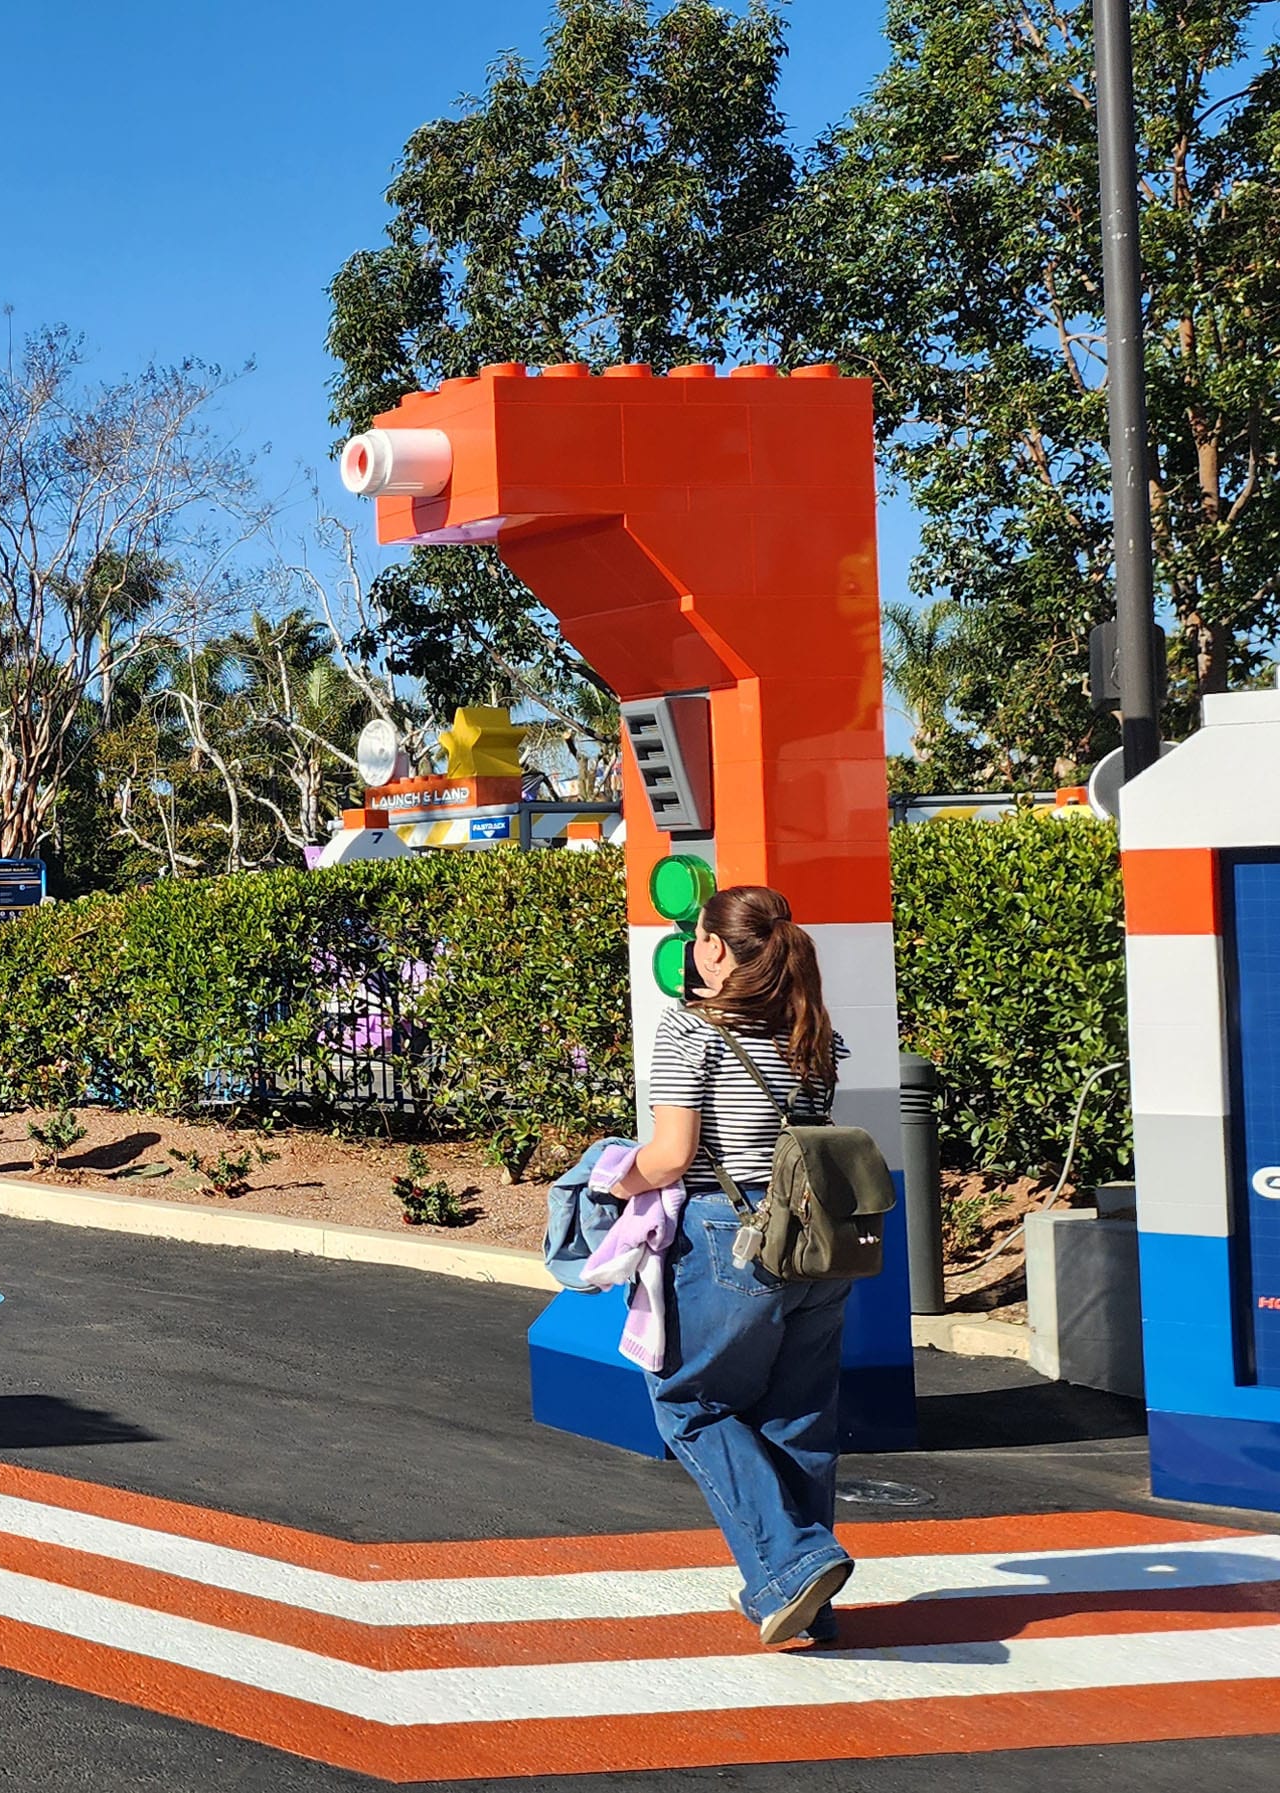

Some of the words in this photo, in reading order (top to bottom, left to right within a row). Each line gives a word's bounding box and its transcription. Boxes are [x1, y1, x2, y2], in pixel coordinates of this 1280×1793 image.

[371, 792, 421, 809] LAUNCH
[423, 793, 432, 802] &
[434, 787, 470, 802] LAND
[372, 832, 384, 844] 7
